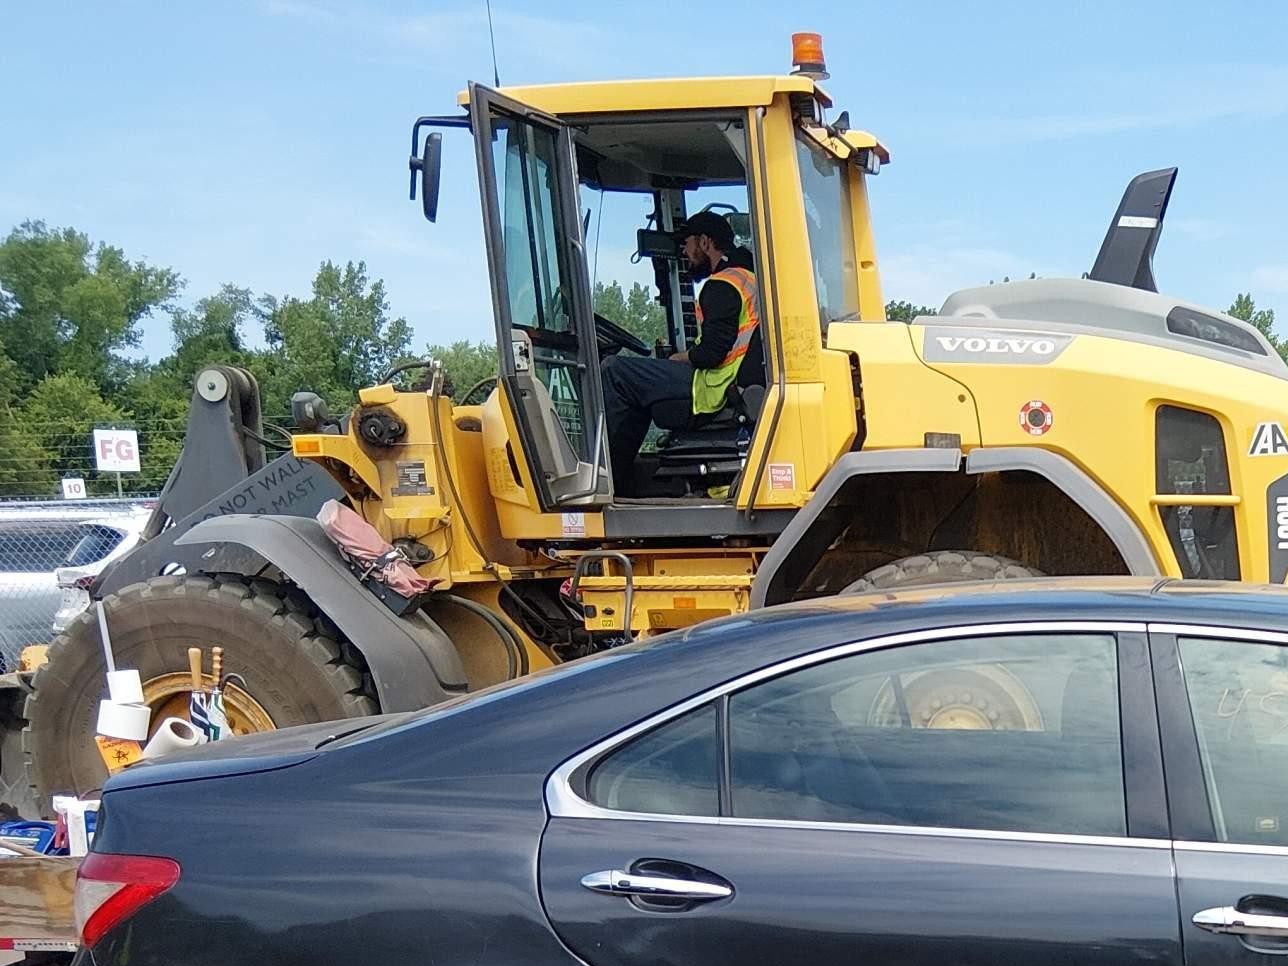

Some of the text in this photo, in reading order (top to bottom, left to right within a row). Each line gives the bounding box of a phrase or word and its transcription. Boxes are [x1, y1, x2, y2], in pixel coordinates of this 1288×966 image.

[936, 336, 1055, 355] VOLVO
[100, 439, 134, 461] FG
[68, 484, 82, 494] 10
[219, 457, 311, 516] NOT WALK
[271, 476, 317, 514] MAST
